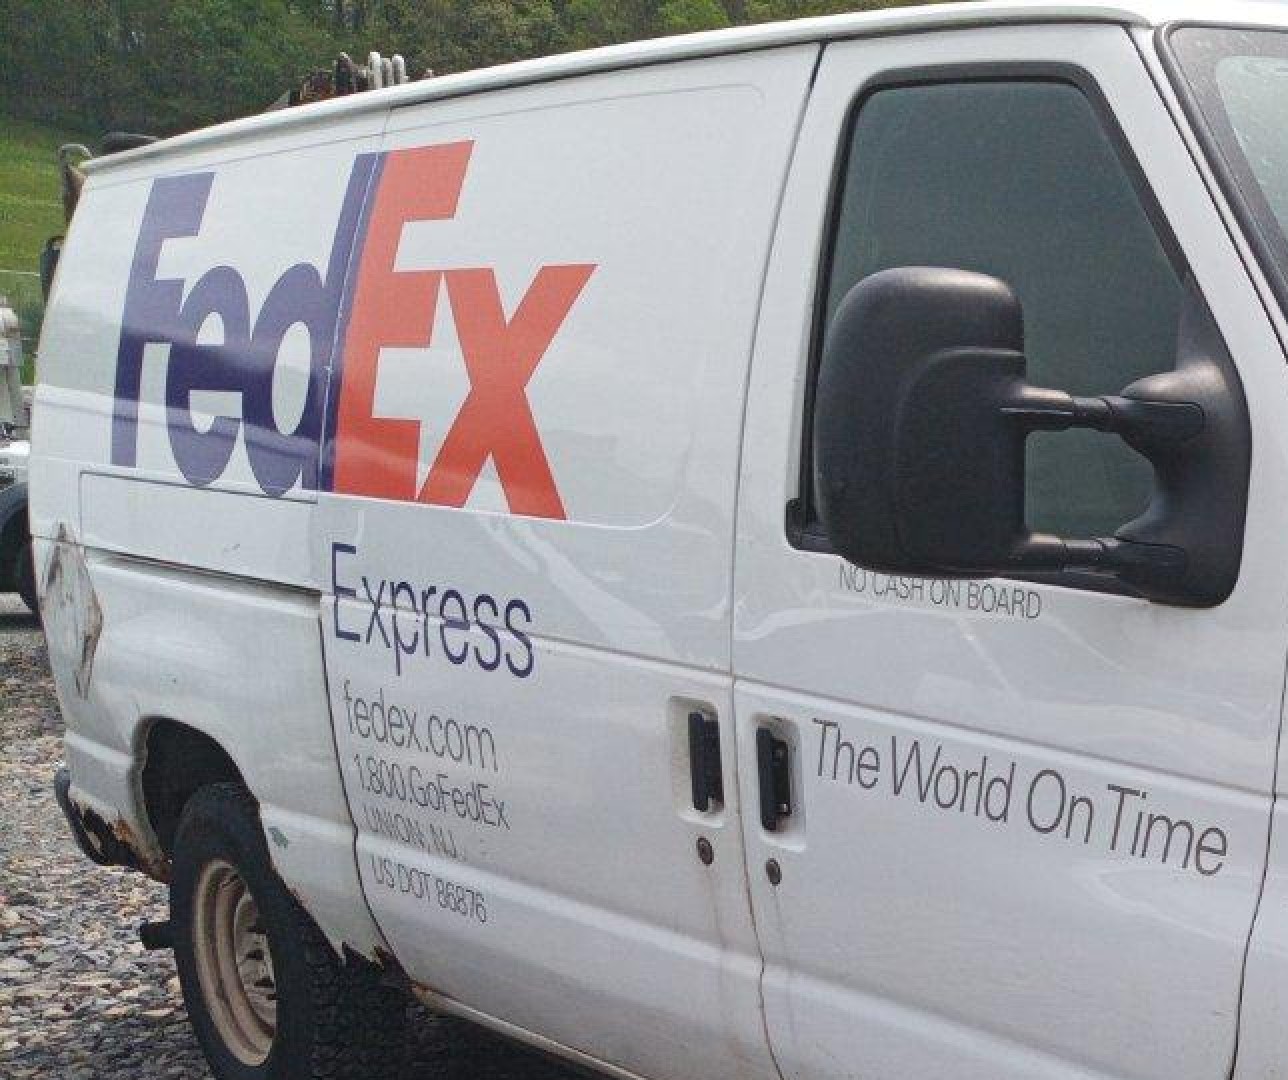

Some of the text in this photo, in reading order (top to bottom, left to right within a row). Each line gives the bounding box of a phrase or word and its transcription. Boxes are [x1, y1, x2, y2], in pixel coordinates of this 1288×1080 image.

[110, 140, 599, 520] FedEx
[331, 542, 534, 678] Express
[873, 572, 925, 602] CASH
[929, 578, 961, 608] ON
[967, 581, 1042, 619] BOARD
[343, 679, 499, 773] fedex.com
[812, 717, 1229, 877] The World On Time
[398, 862, 431, 903] DOT
[435, 877, 487, 923] 86876
